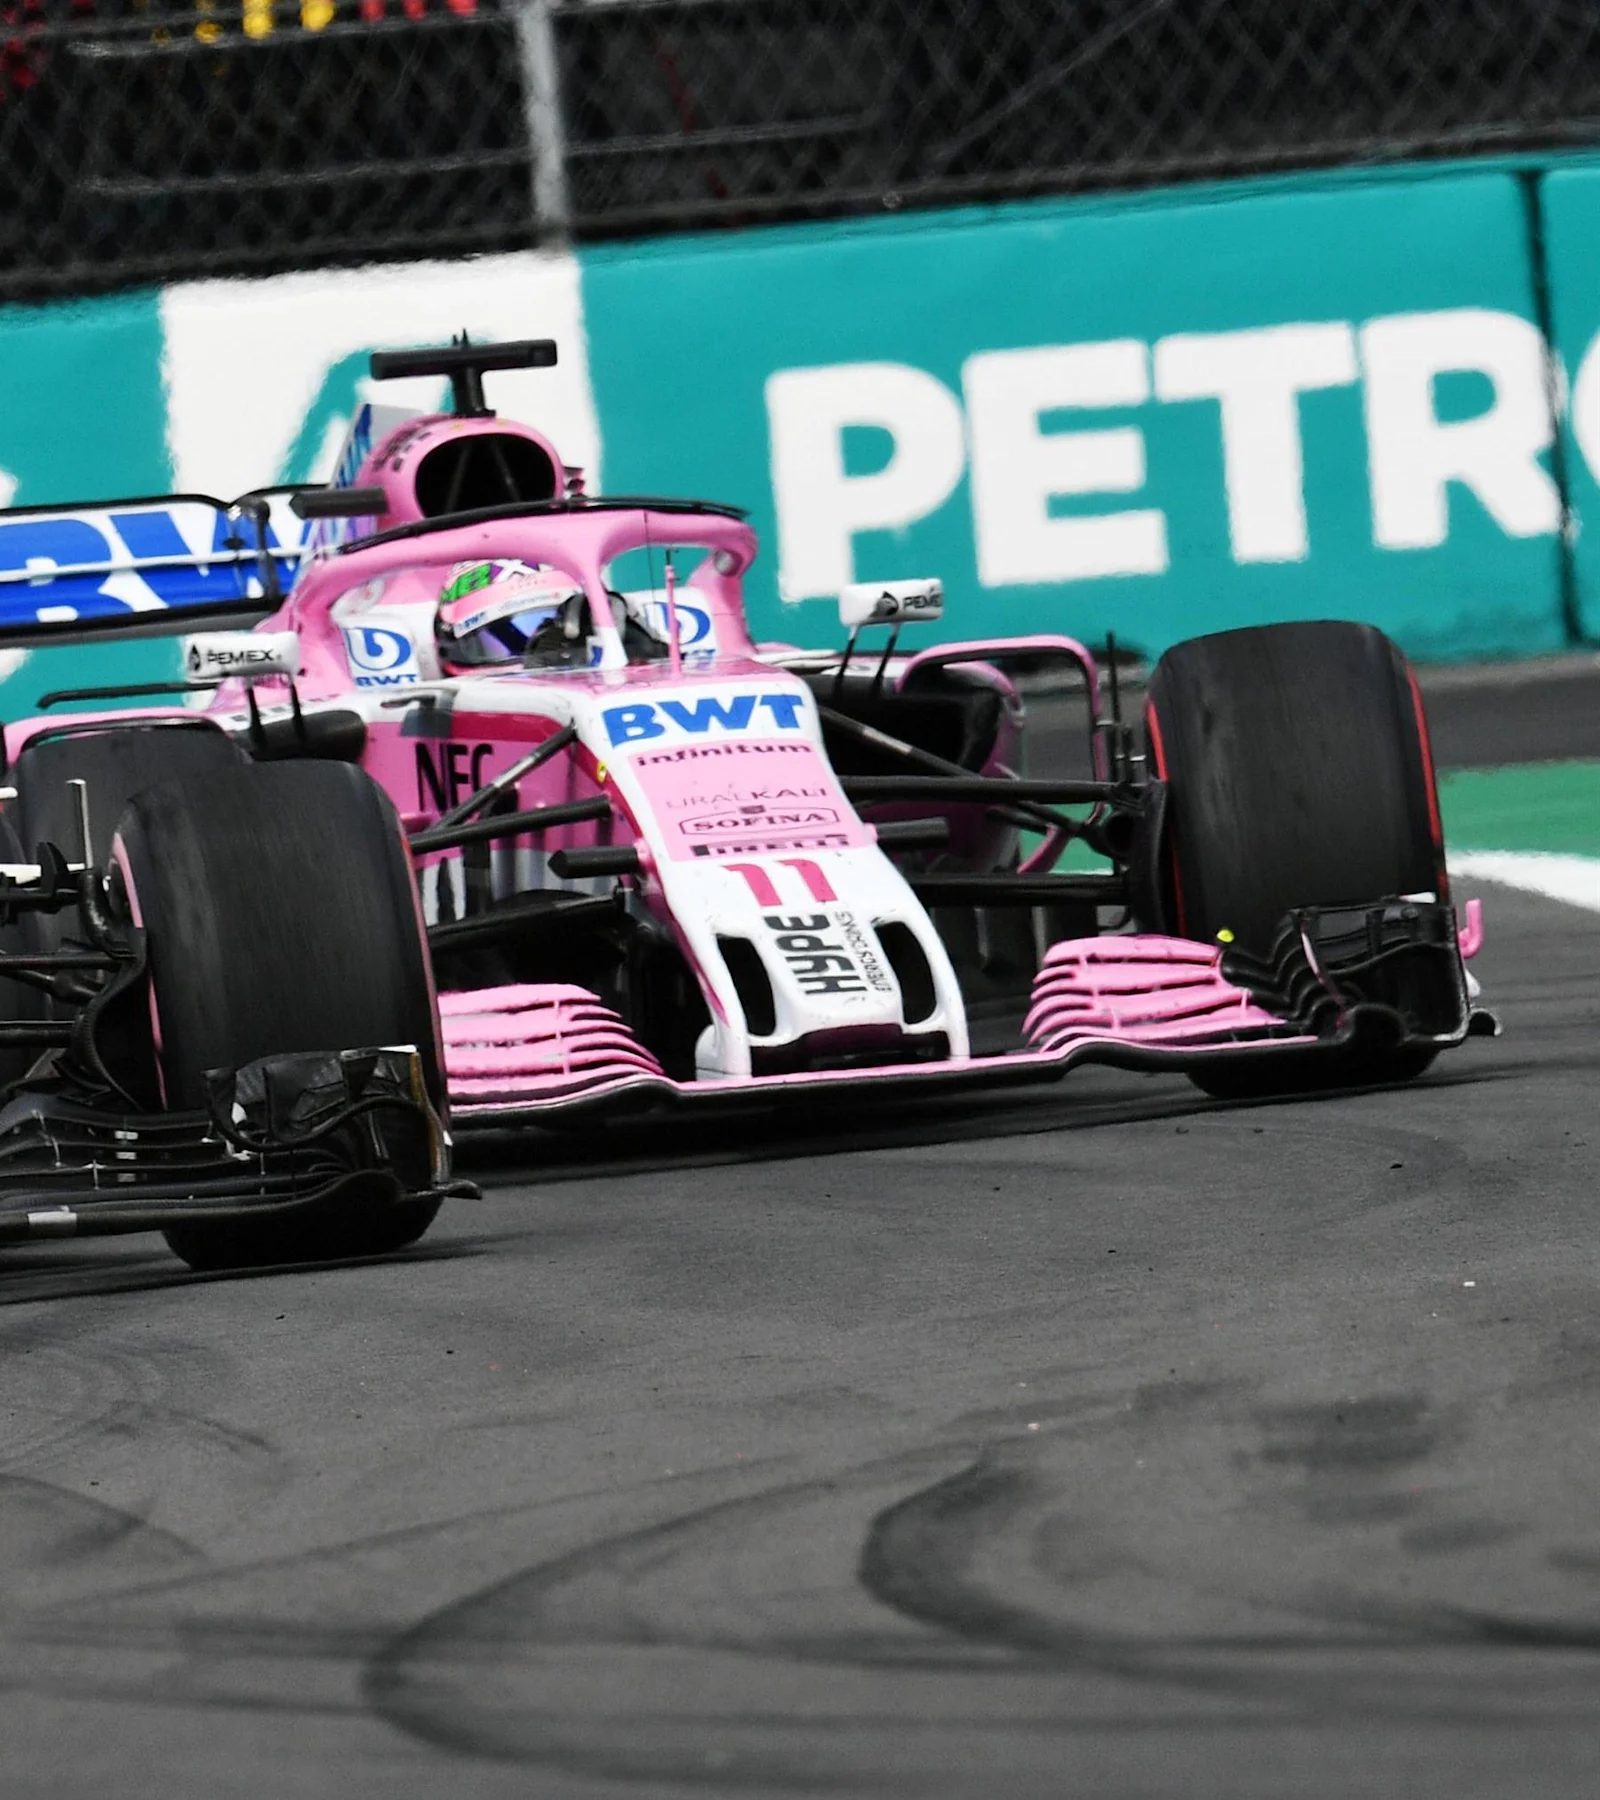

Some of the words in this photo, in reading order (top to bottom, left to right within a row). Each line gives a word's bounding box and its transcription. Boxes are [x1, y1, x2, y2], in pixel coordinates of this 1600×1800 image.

[764, 306, 1600, 602] PETR
[207, 648, 275, 665] PEMEX
[602, 694, 804, 748] BWT
[637, 744, 812, 766] infinitum
[693, 811, 827, 831] SOFINA
[721, 858, 839, 908] 11
[763, 913, 869, 995] HYPE
